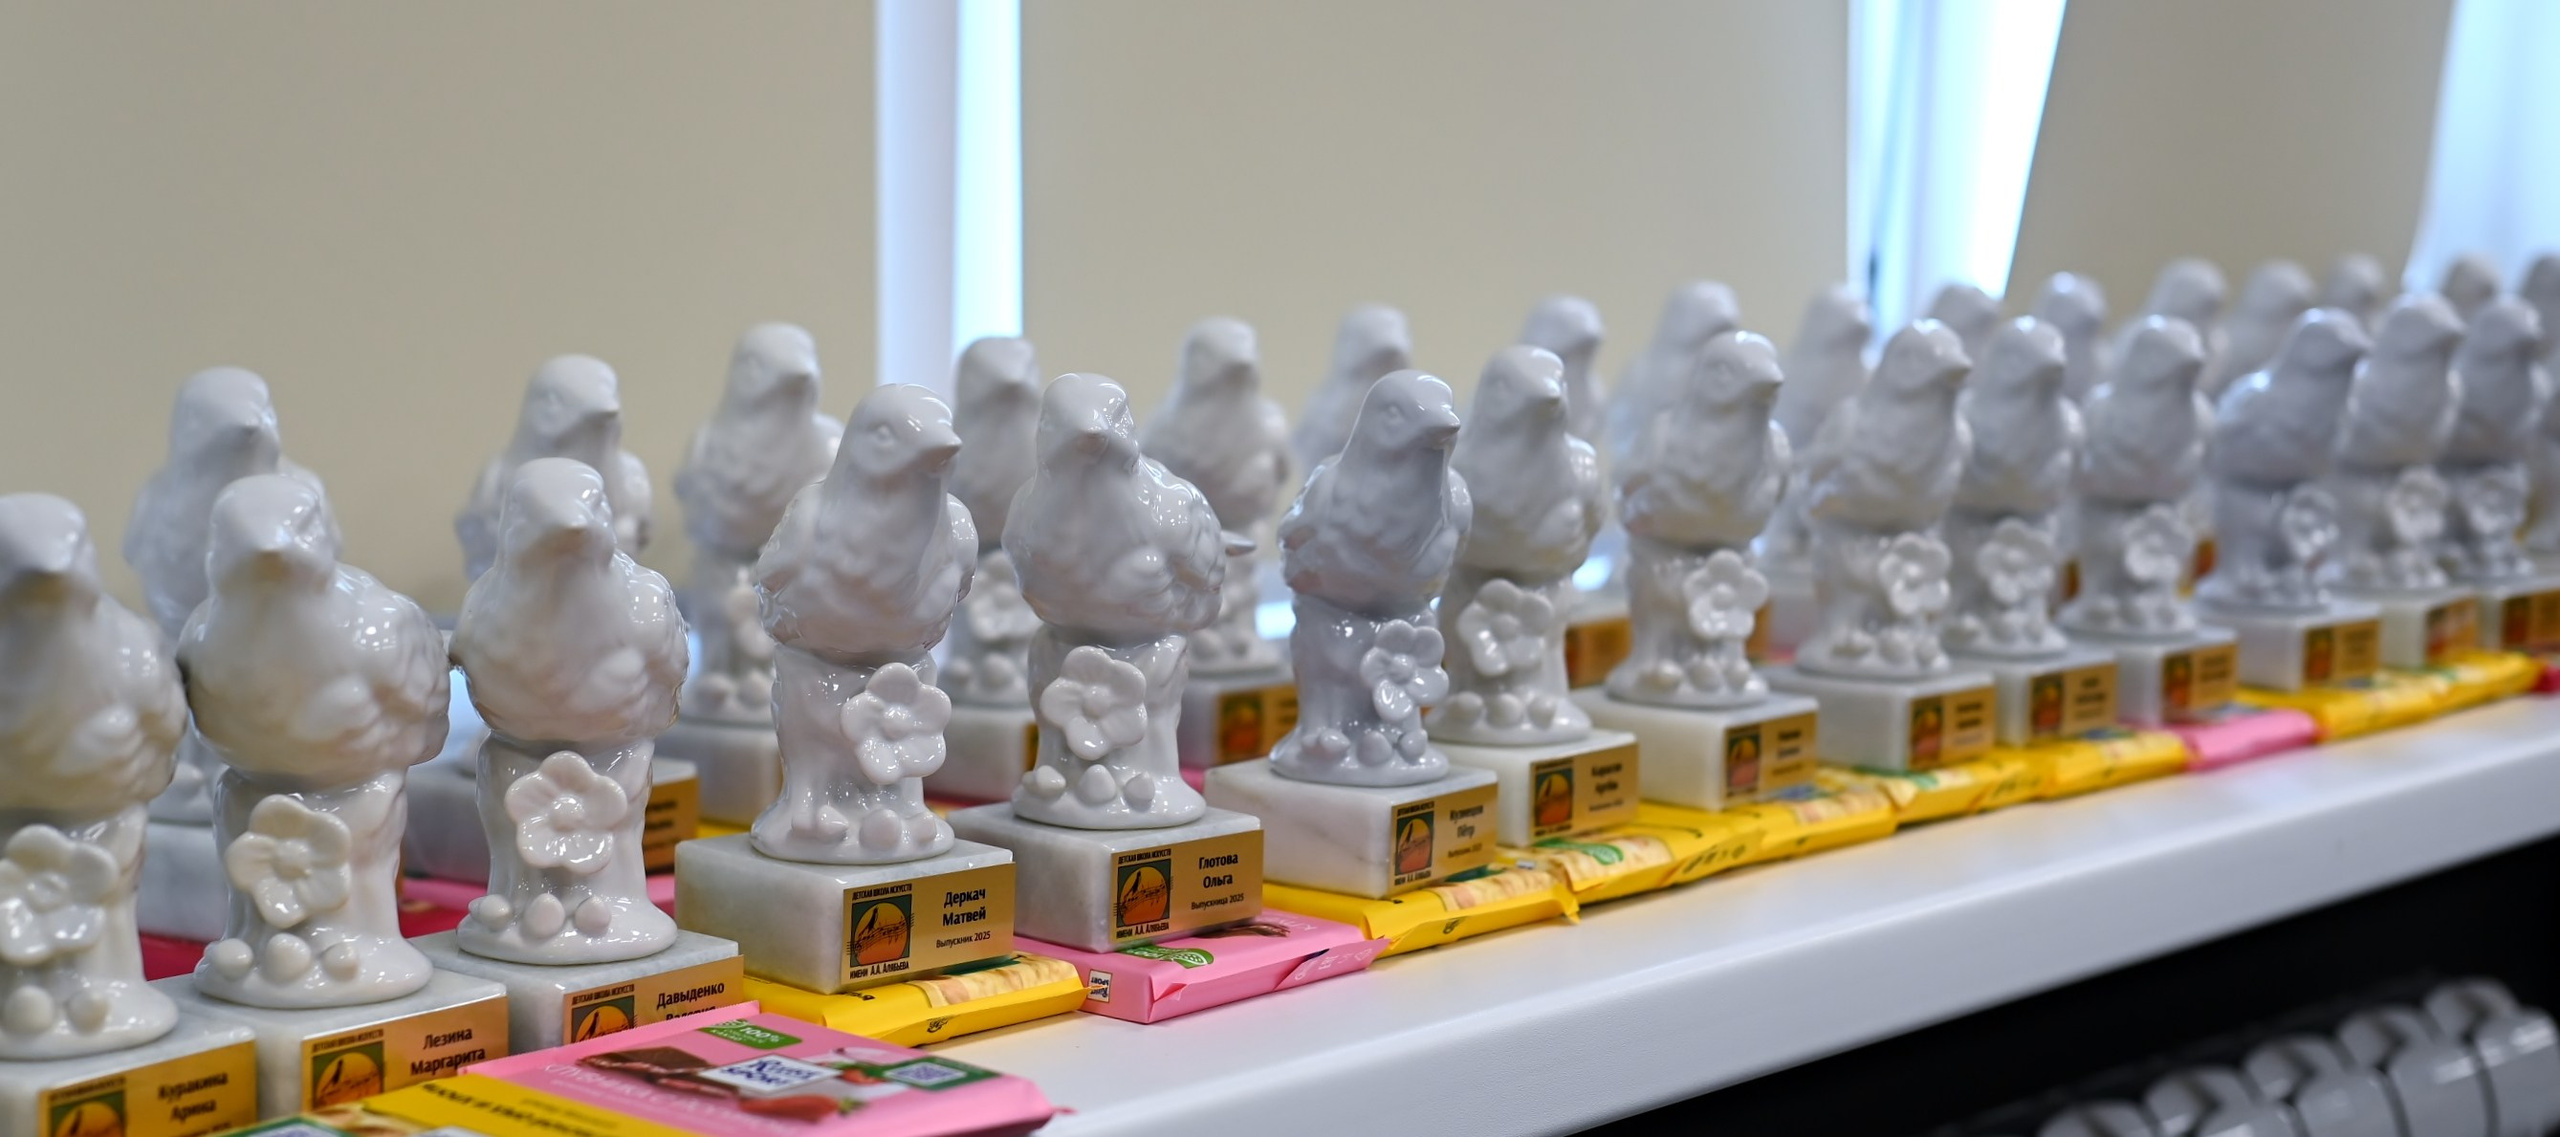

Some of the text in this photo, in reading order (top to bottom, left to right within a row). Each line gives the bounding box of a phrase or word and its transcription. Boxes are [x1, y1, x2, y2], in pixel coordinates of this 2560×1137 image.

[1198, 853, 1239, 870] Глотова
[1203, 874, 1233, 889] Ольга
[852, 883, 913, 900] ДЕТСКАЯ ШКОЛА ИСКУССТВ
[943, 889, 986, 909] Деркач
[1191, 893, 1245, 911] Выпускница 2025
[942, 906, 986, 926] Матвей
[936, 930, 991, 950] Выпускник 2025
[850, 968, 868, 980] ИМЕНИ
[656, 982, 725, 1010] Давыденко
[423, 1028, 473, 1050] Лезина
[740, 1027, 780, 1043] 100%
[410, 1048, 486, 1076] Маргарита
